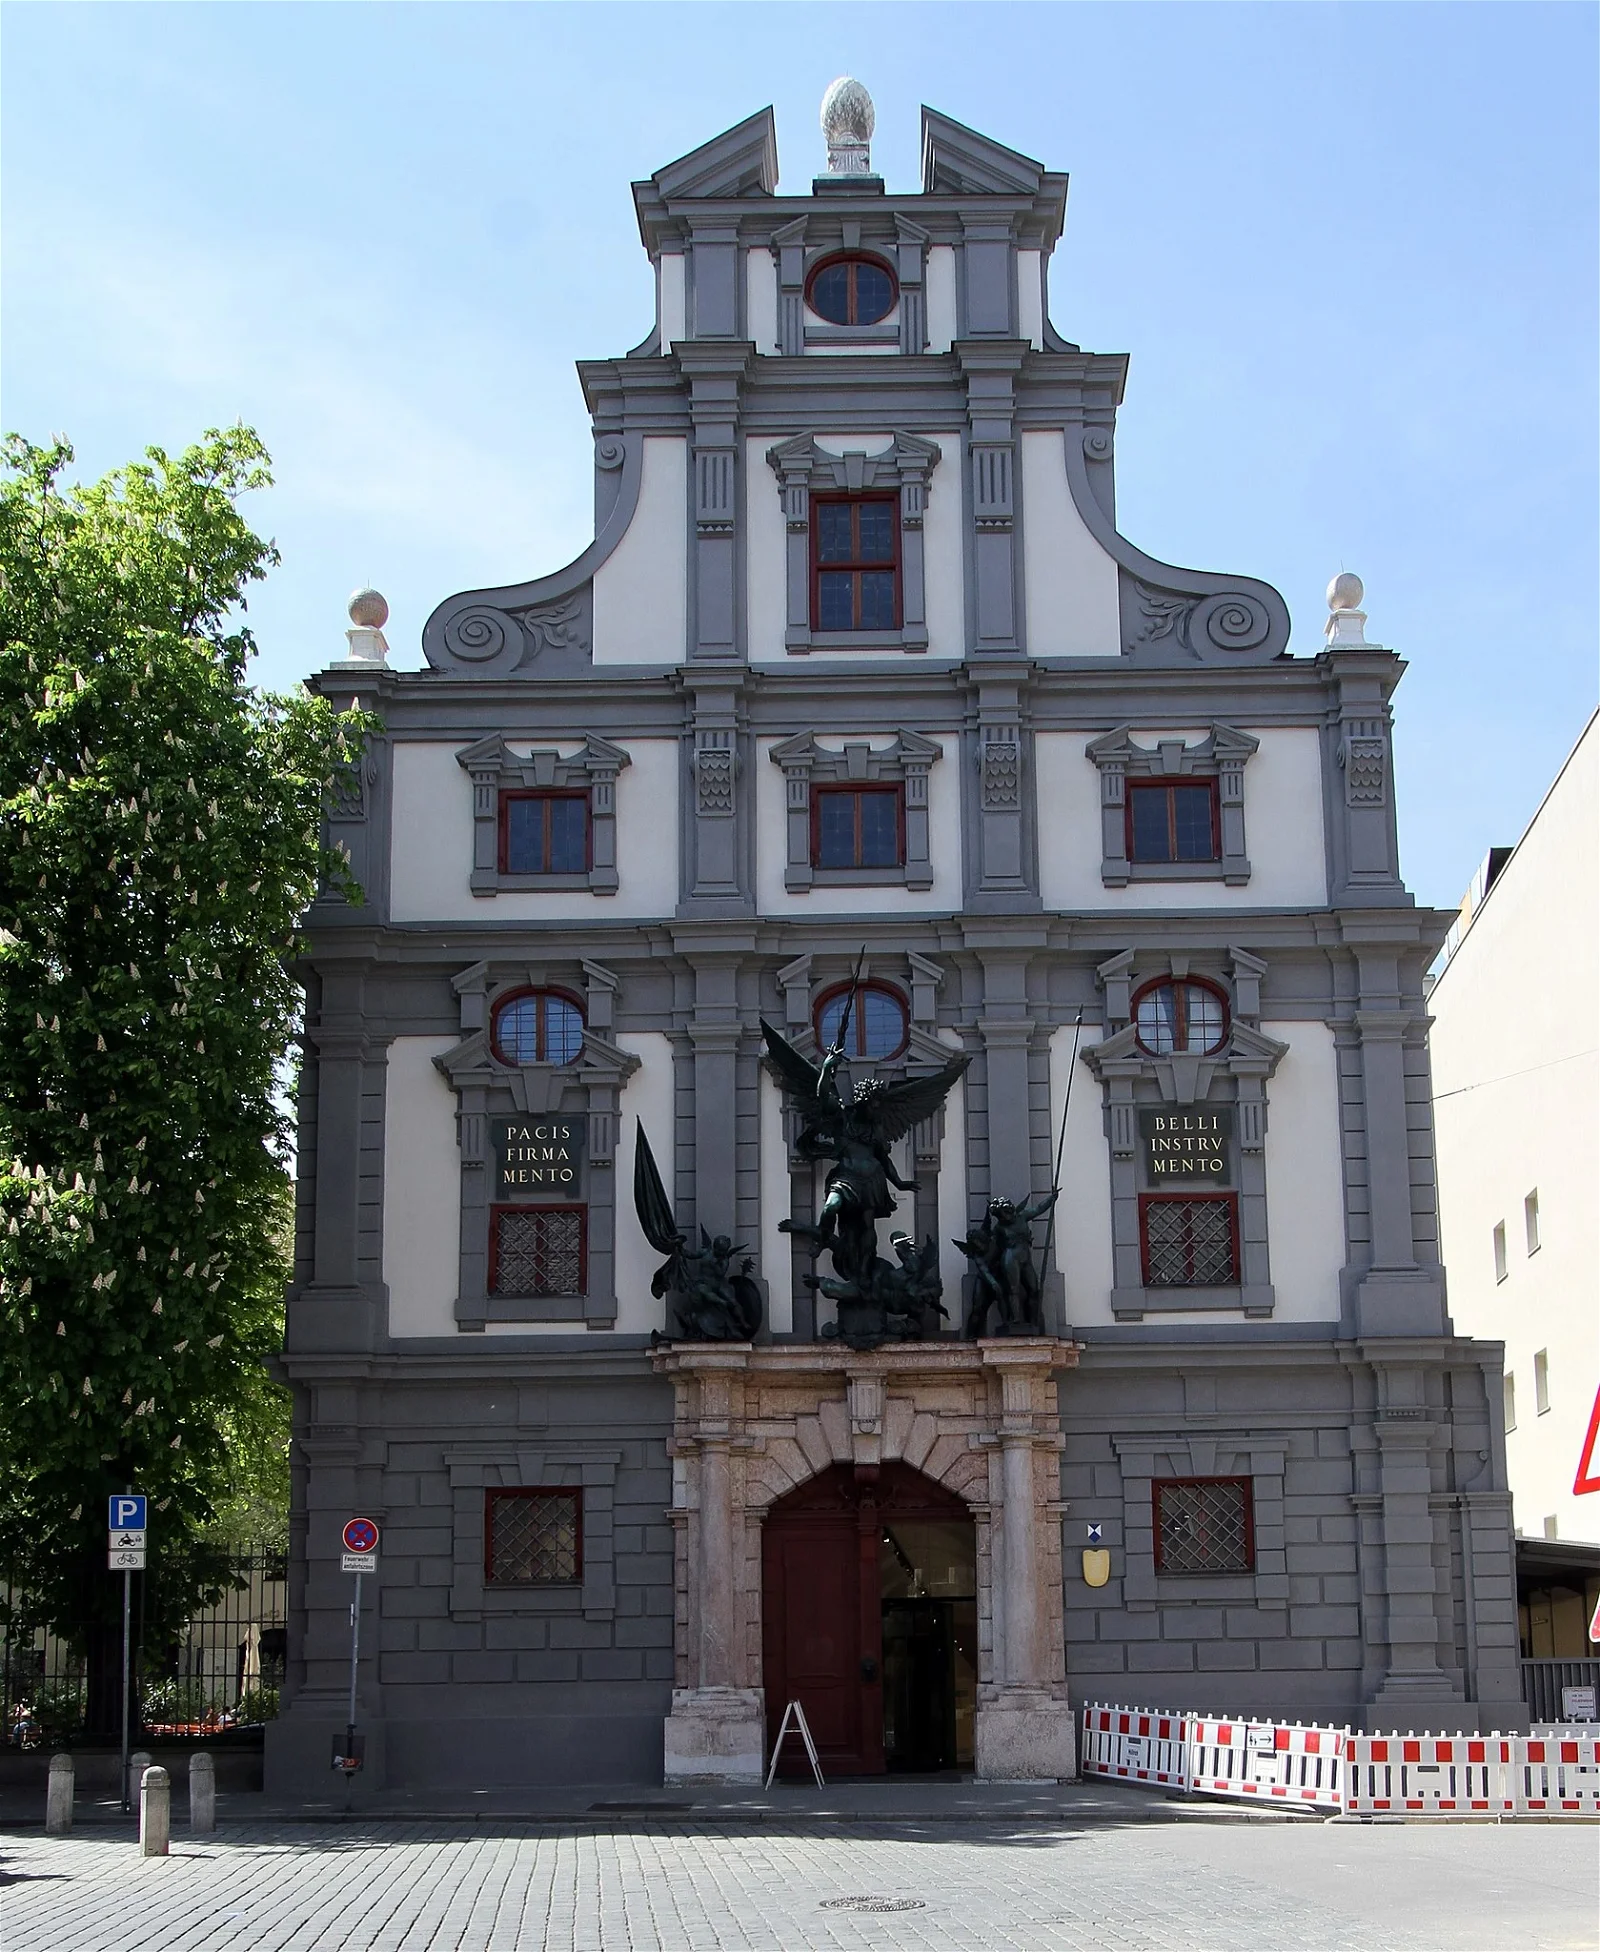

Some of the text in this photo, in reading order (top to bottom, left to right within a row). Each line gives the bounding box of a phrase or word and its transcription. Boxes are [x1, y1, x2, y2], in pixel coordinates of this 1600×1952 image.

[1155, 1116, 1218, 1130] BELLI
[507, 1126, 570, 1140] PACIS
[1151, 1137, 1223, 1151] INSTRV
[507, 1147, 569, 1161] FIRMA
[1154, 1158, 1223, 1173] MENTO
[503, 1168, 573, 1183] MENTO
[118, 1500, 138, 1525] P
